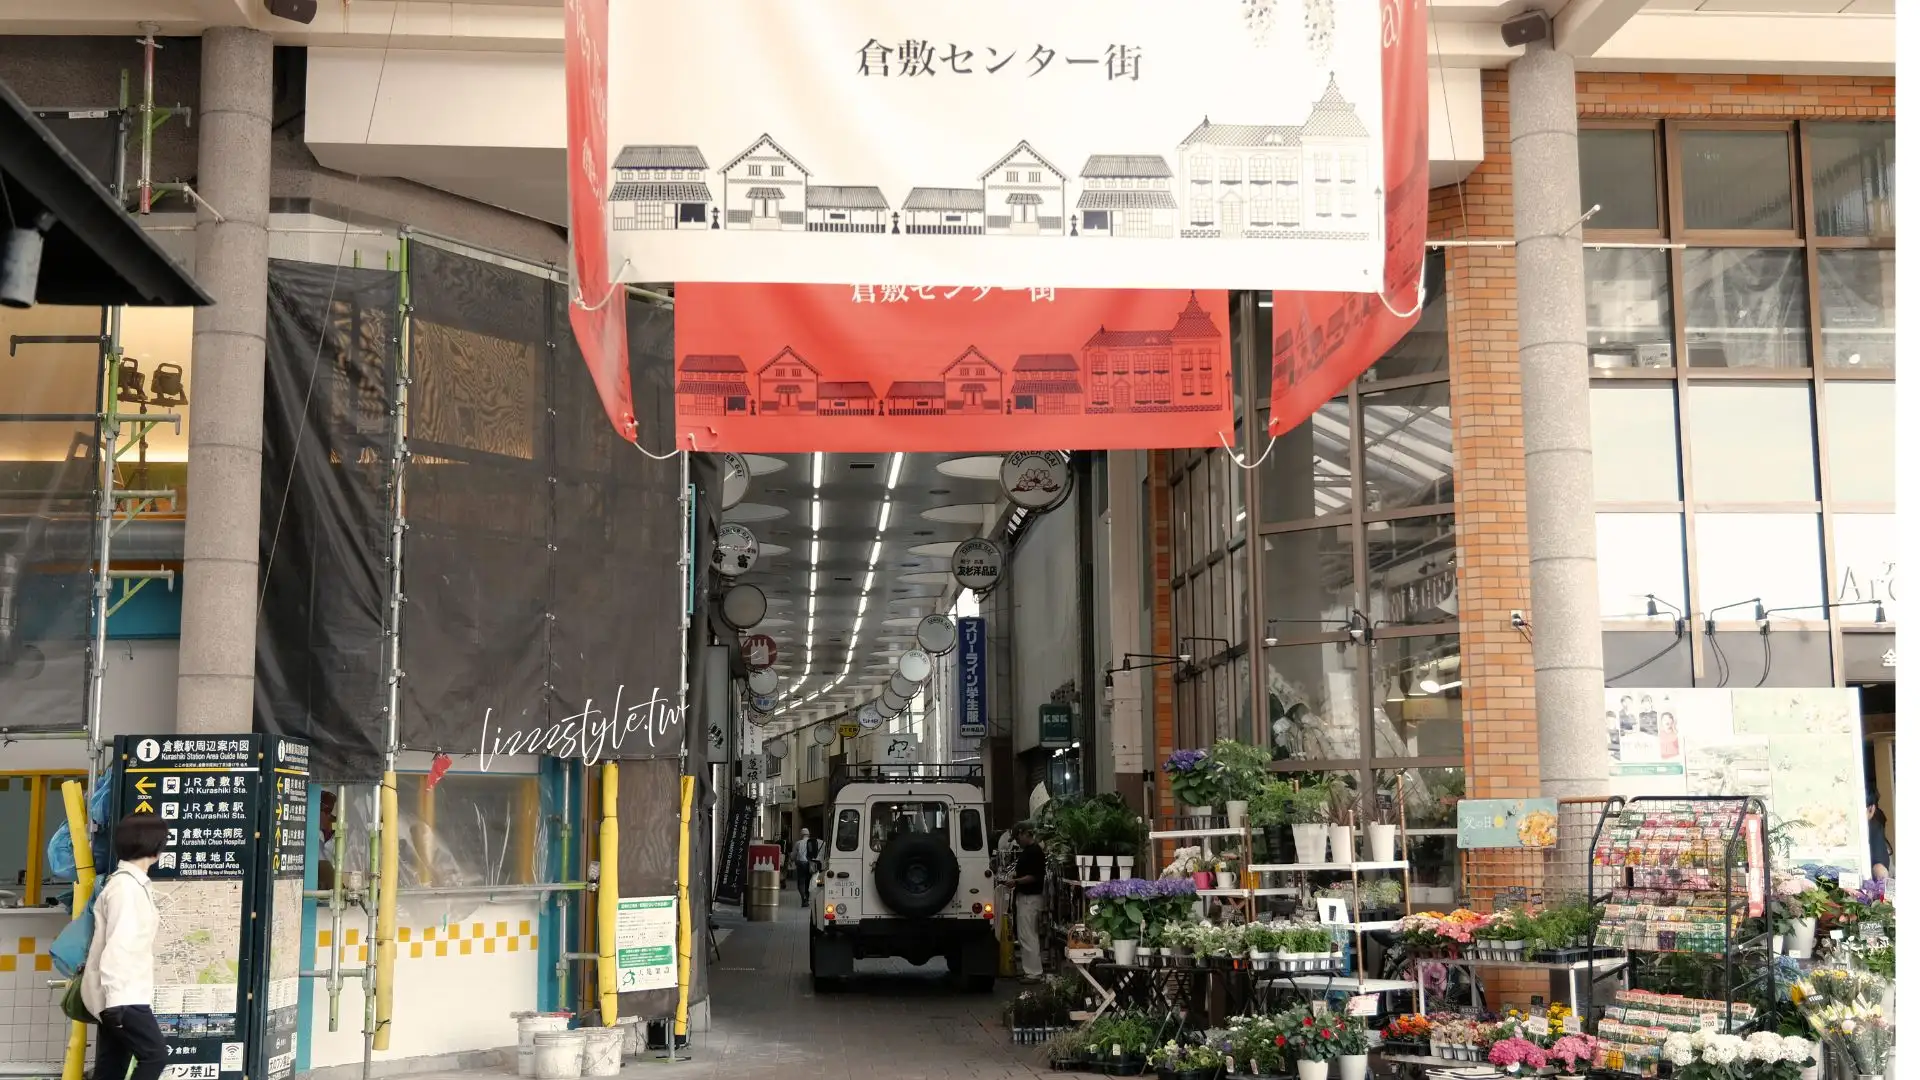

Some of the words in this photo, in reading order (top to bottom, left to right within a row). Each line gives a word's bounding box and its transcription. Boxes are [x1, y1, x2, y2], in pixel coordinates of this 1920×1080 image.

[855, 38, 1143, 82] 倉敷センター街
[965, 621, 980, 724] スリーライン学生服
[162, 739, 250, 753] 倉敷駅周辺案内図
[161, 752, 186, 760] Kurashiki
[186, 752, 206, 760] Station
[206, 752, 219, 760] Area
[219, 752, 236, 760] Guide
[236, 752, 249, 761] Map
[184, 776, 246, 787] JR倉敷駅
[182, 801, 244, 812] JR倉敷駅
[195, 812, 230, 820] Kurashiki
[1463, 815, 1492, 830] 父の日
[182, 828, 244, 839] 倉敷中央病院
[207, 838, 222, 846] Chuo
[223, 838, 246, 847] Hospital
[181, 851, 236, 863] 美観地区
[175, 1044, 198, 1055] 倉敷市
